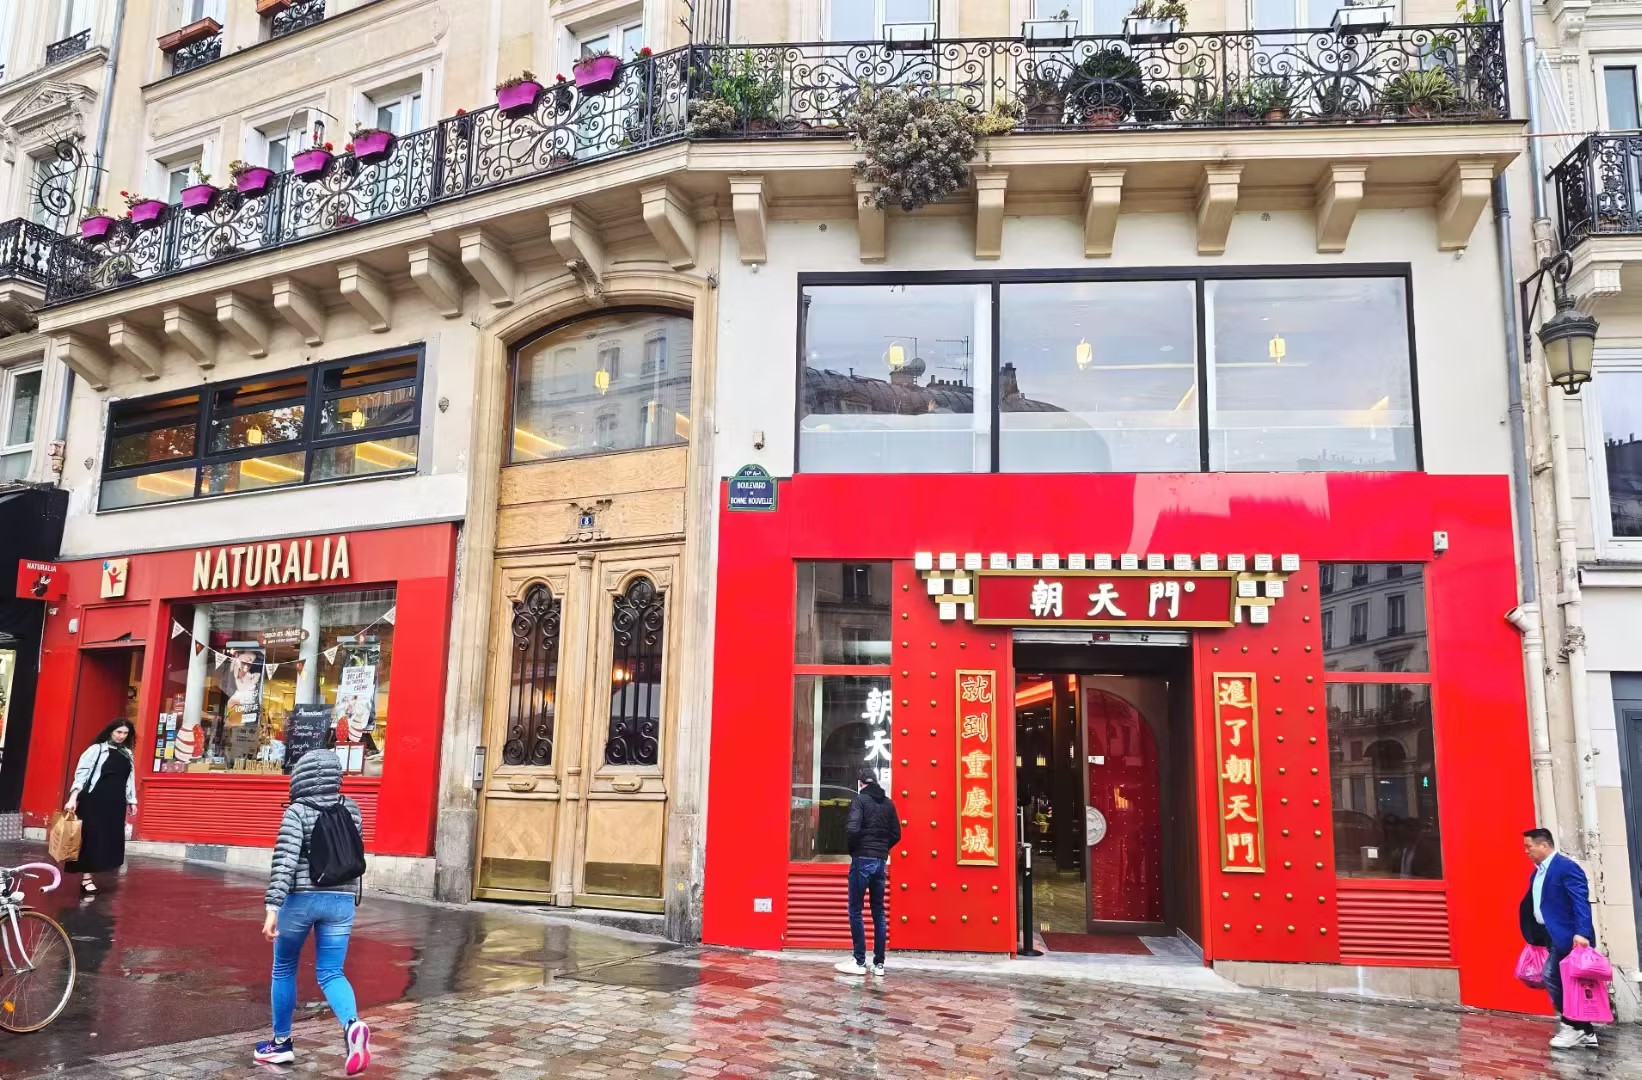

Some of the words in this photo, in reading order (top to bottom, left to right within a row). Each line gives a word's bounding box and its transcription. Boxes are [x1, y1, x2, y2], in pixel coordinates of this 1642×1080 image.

[26, 562, 57, 573] NATURALIA
[192, 535, 350, 591] NATURALIA
[961, 675, 994, 857] 就到重慶城
[1218, 680, 1258, 863] 進了朝天門
